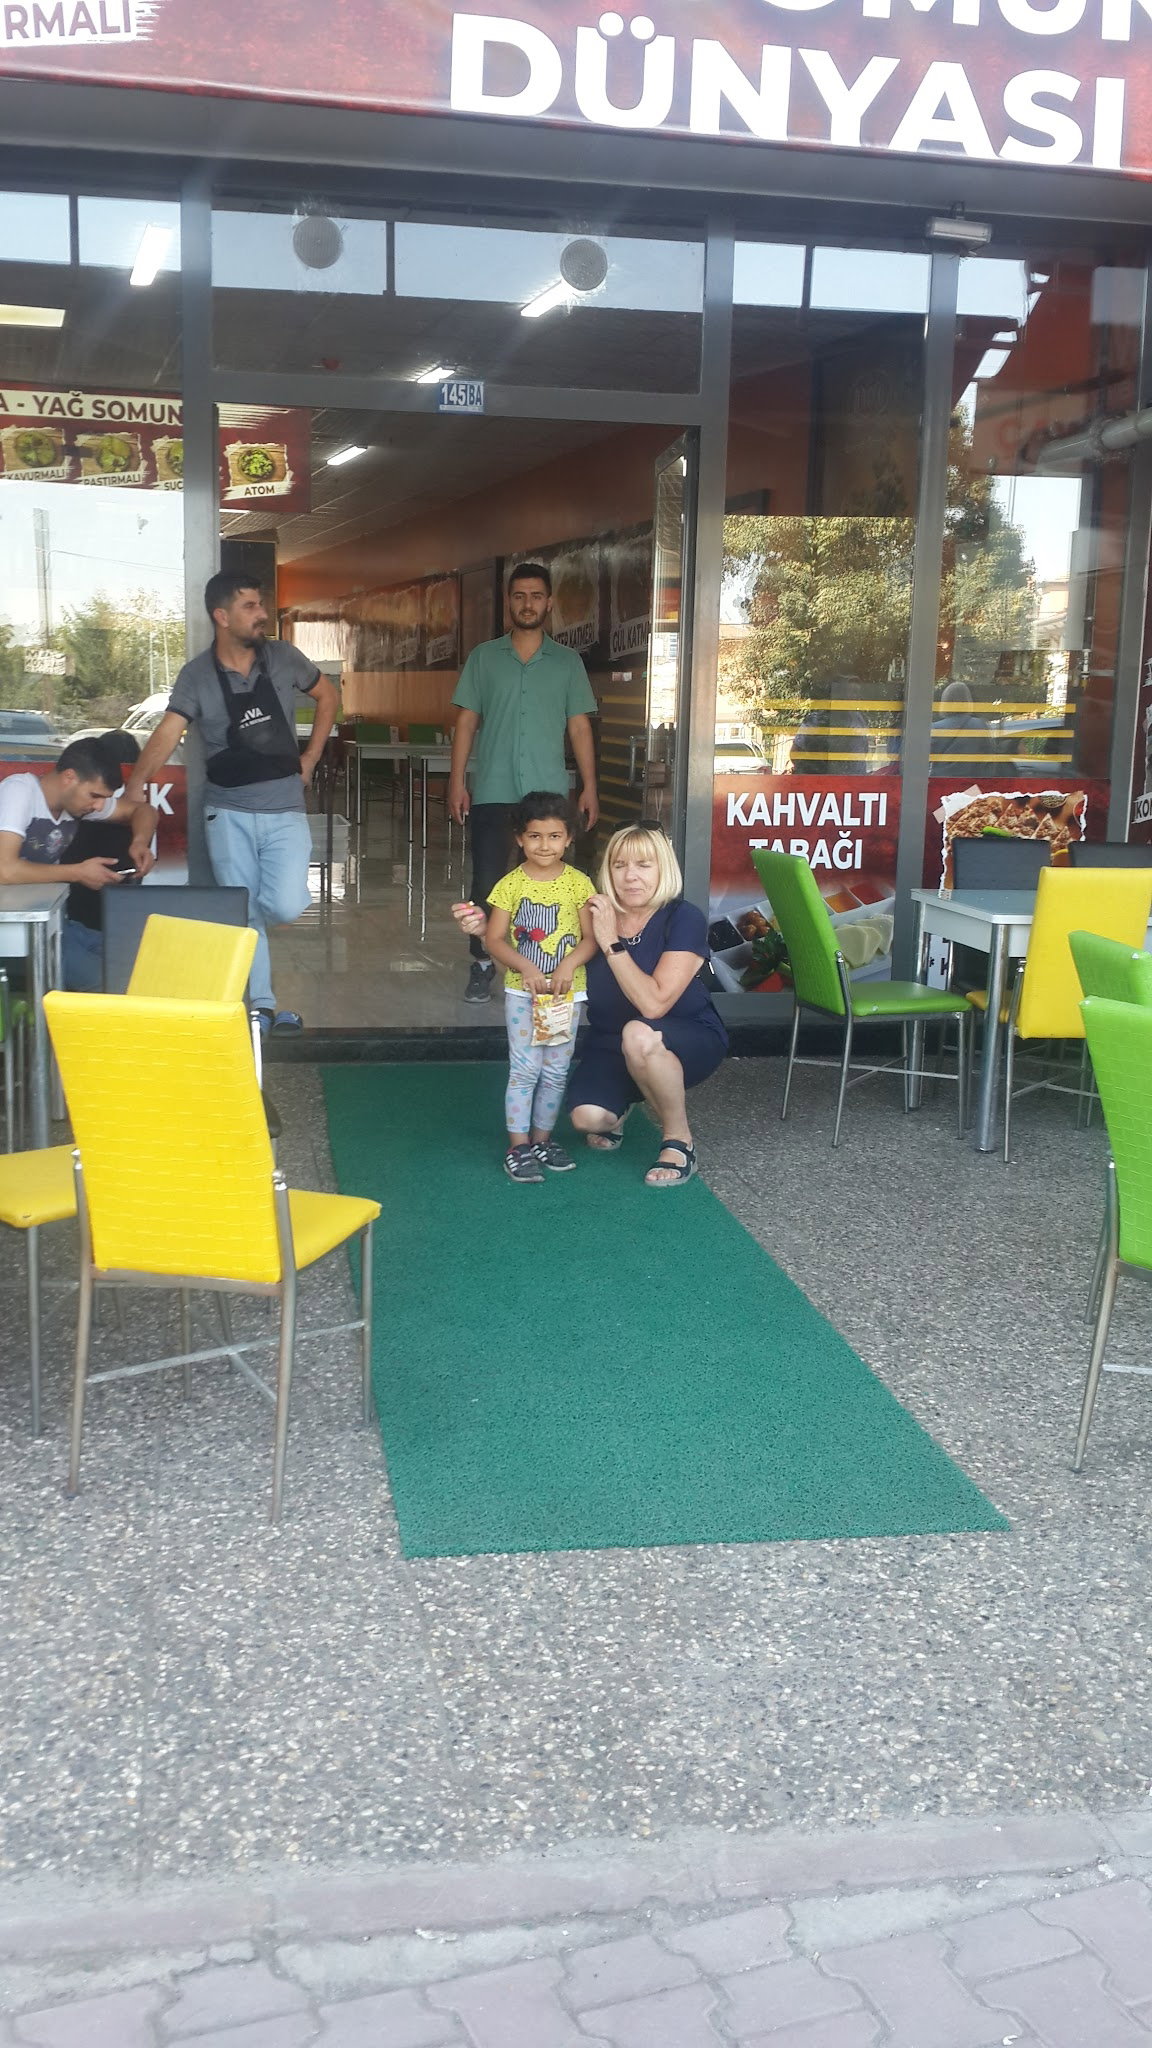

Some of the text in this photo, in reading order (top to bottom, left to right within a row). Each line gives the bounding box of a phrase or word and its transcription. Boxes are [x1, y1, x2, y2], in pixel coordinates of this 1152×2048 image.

[450, 11, 1126, 170] DÜNYASI
[32, 391, 84, 418] YAĞ
[92, 402, 184, 424] SOMUN
[164, 480, 184, 491] SUC
[244, 485, 275, 496] ATOM
[726, 792, 888, 827] KAHVALTI
